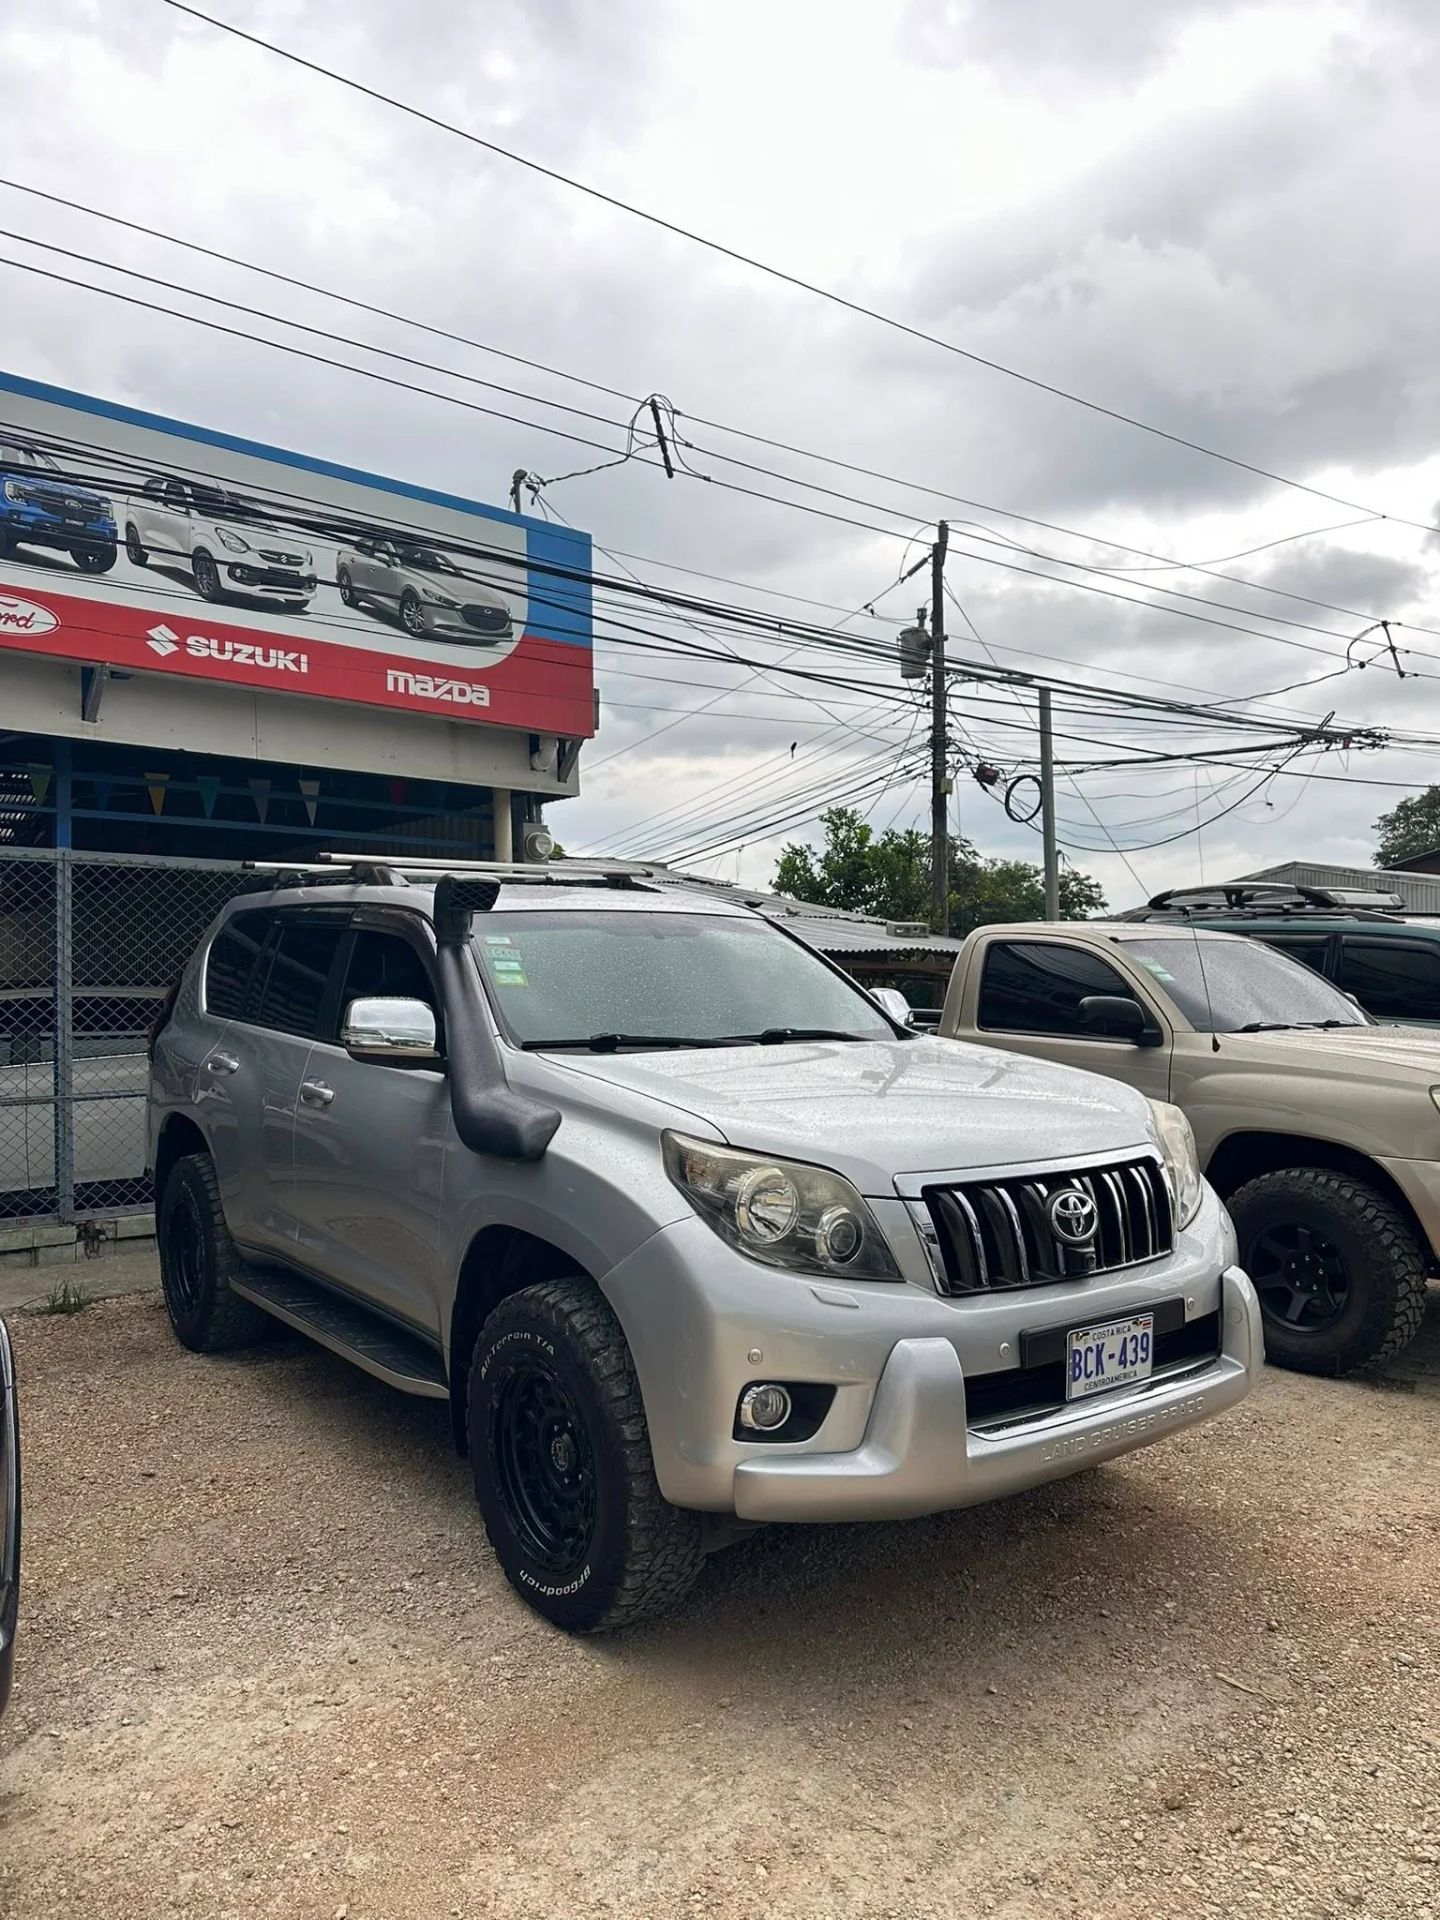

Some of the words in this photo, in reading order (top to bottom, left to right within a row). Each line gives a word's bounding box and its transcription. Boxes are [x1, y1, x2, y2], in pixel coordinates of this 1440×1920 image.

[186, 635, 308, 673] SUZUKI
[535, 1334, 555, 1356] T/A
[1092, 1329, 1115, 1341] COSTA
[1116, 1325, 1131, 1335] RICA
[1072, 1331, 1150, 1382] BCK-439
[1084, 1370, 1138, 1391] CENTROAMERICA
[1041, 1436, 1086, 1462] LAND
[1091, 1414, 1156, 1446] CRUISER
[519, 1563, 591, 1596] BFGoodrich
